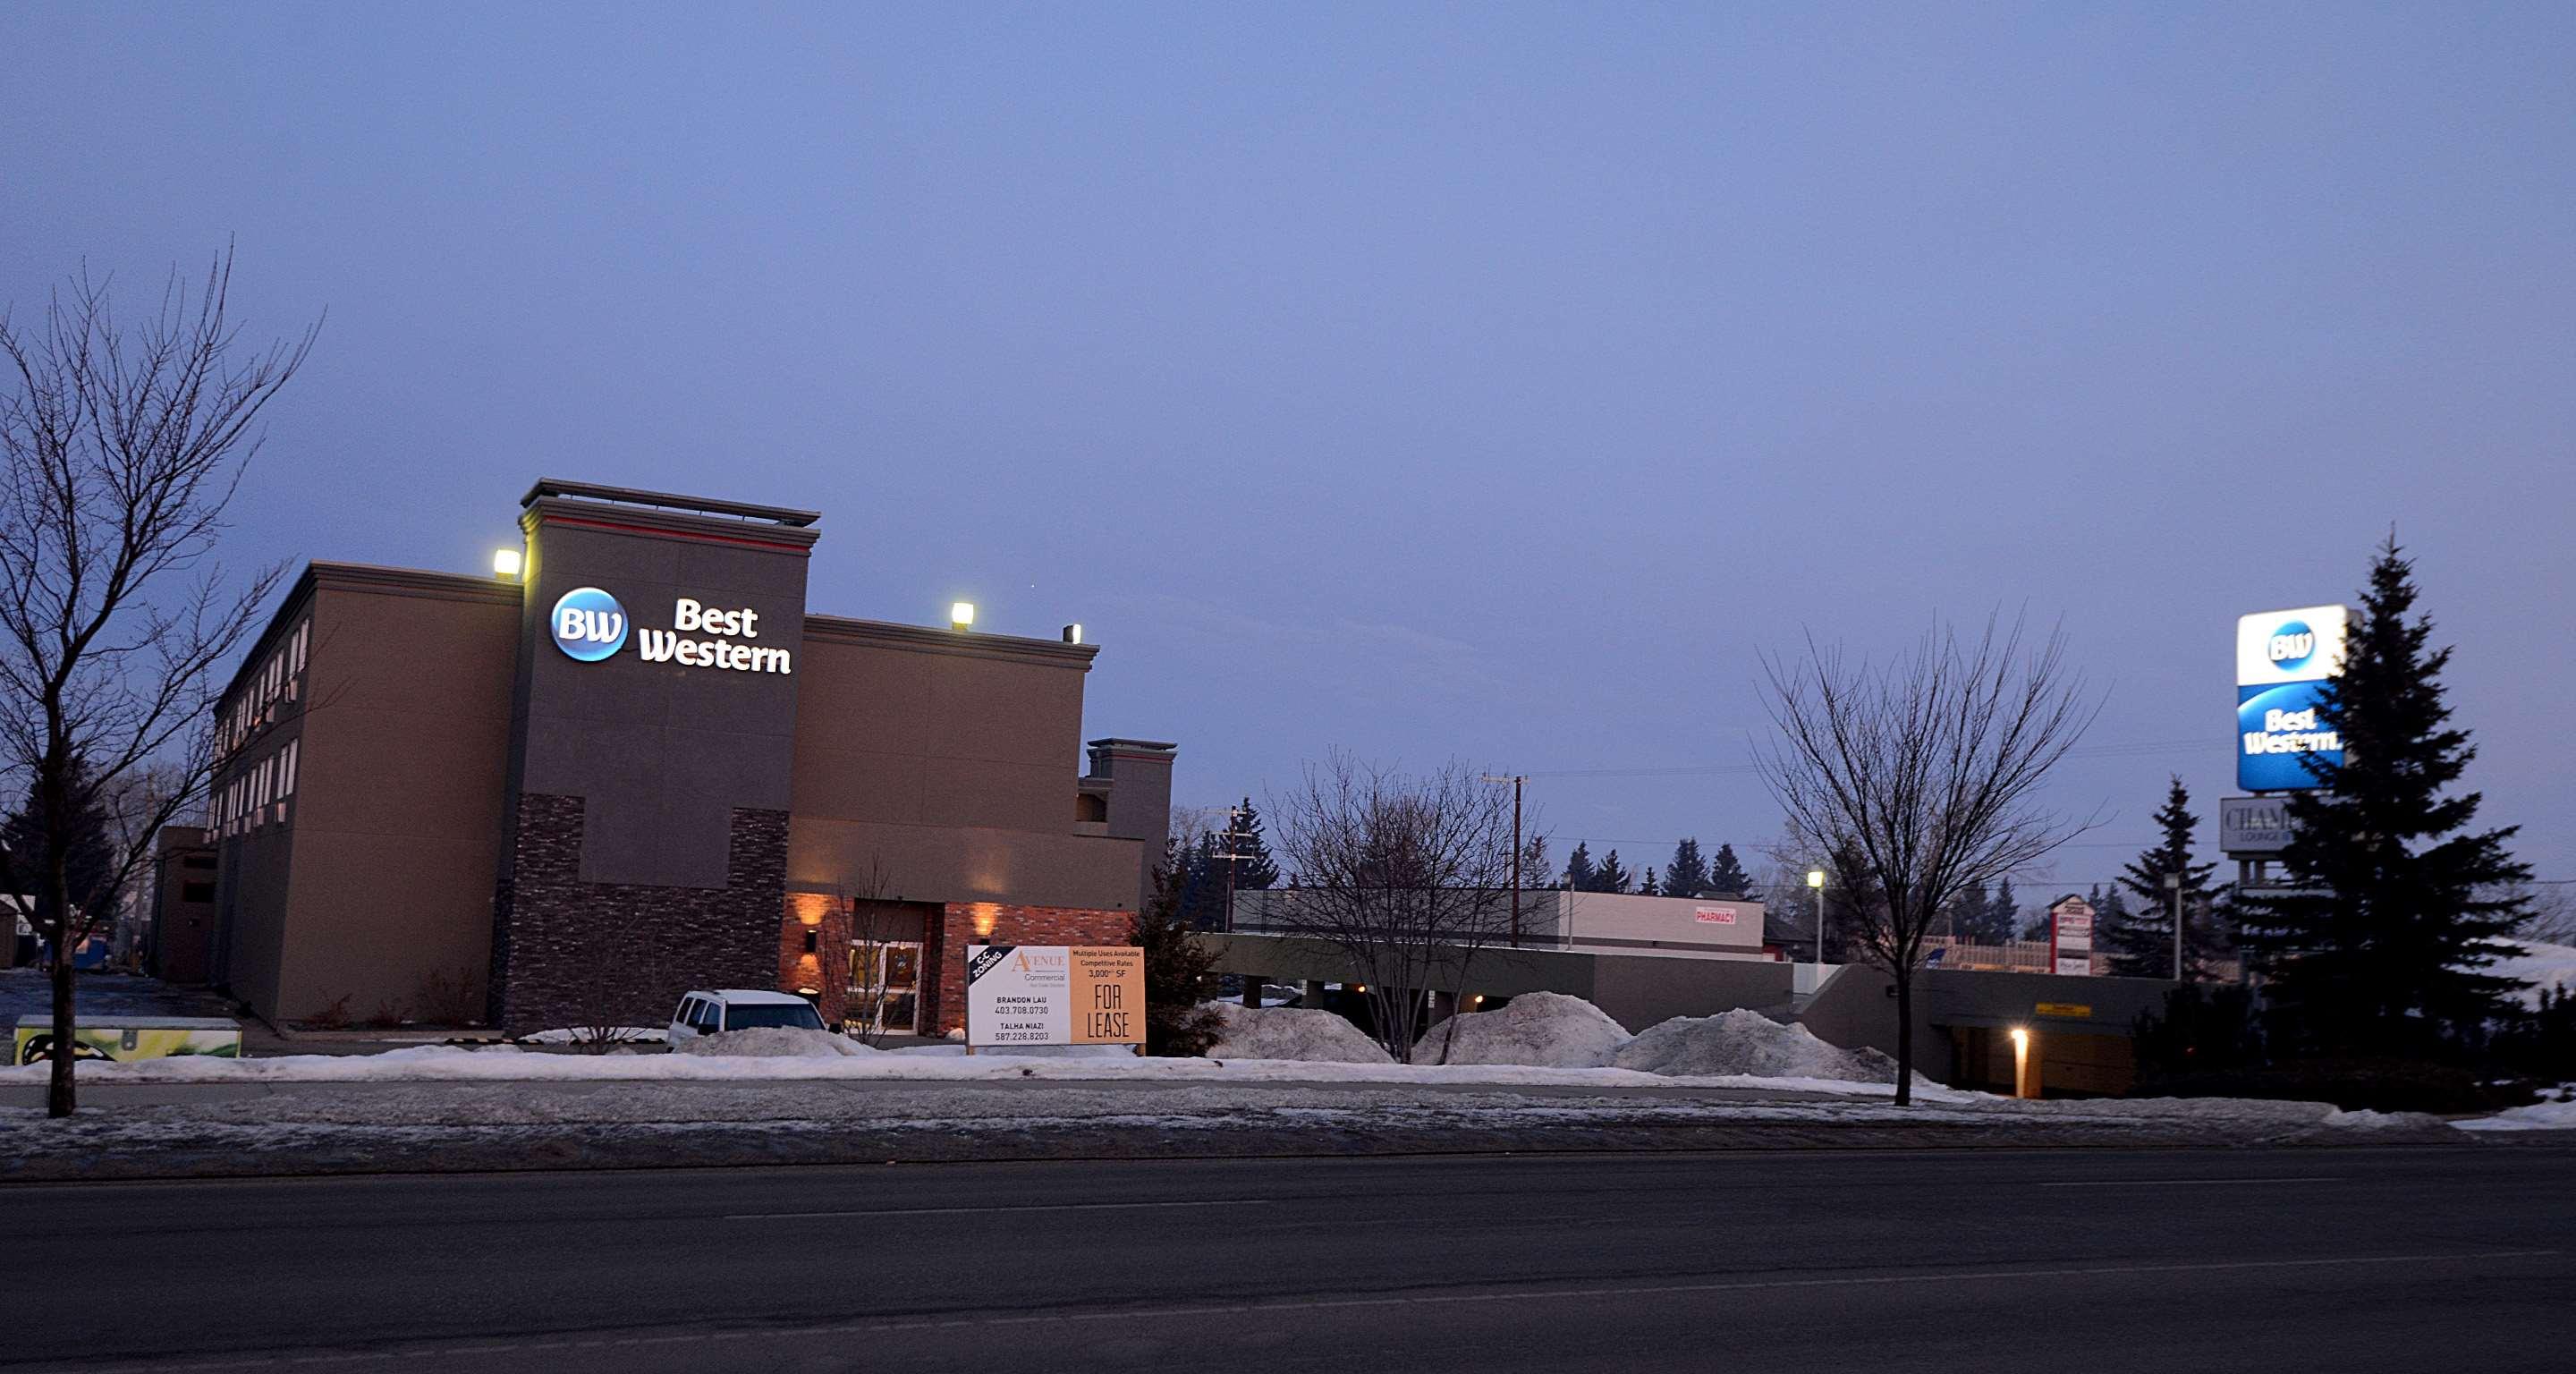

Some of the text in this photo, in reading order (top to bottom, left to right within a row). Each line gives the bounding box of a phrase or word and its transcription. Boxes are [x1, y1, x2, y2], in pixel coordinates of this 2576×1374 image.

[559, 607, 623, 643] BW
[674, 598, 758, 638] Best
[639, 628, 792, 674] Western
[2269, 632, 2313, 661] BW
[2265, 708, 2318, 732] Best
[1696, 911, 1734, 923] PHARMACY
[972, 951, 1003, 978] ZONING
[977, 951, 990, 964] C-C
[1072, 950, 1097, 958] Multiple
[1024, 973, 1065, 981] Commercial
[1116, 970, 1126, 978] SF
[1095, 984, 1122, 1010] FOR
[995, 1006, 1049, 1014] 403.708.0730
[1087, 1012, 1130, 1039] LEASE
